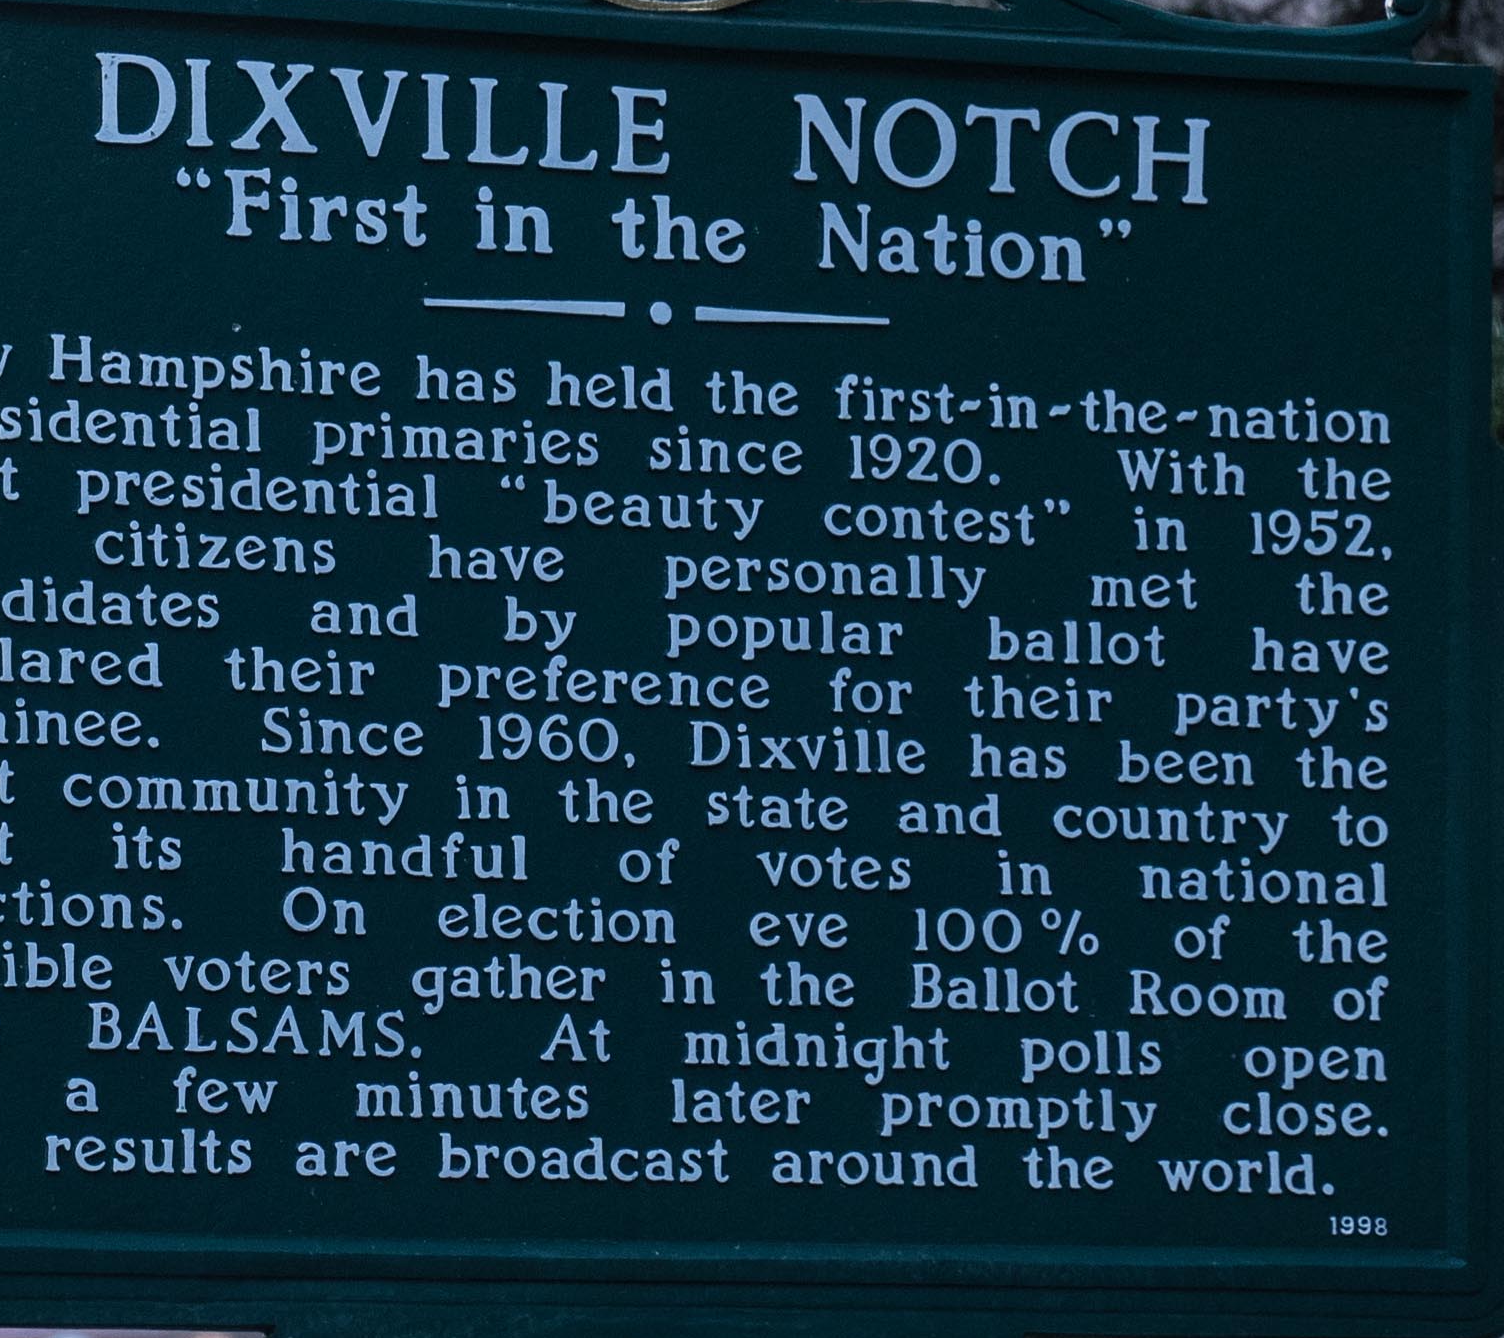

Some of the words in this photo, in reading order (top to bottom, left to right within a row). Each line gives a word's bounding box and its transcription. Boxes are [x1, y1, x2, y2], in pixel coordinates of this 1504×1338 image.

[92, 50, 672, 175] DIXVILLE
[791, 92, 1212, 206] NOTCH
[473, 184, 555, 255] in
[609, 193, 748, 265] the
[47, 331, 382, 401] Hampshire
[414, 353, 518, 405] has
[545, 359, 675, 413] held
[703, 368, 800, 418] the
[310, 410, 600, 468] primaries
[648, 423, 804, 477] since
[848, 431, 1002, 487] 1920.
[1115, 446, 1246, 497] With
[1295, 455, 1393, 503] the
[75, 461, 439, 520] presidential
[1132, 504, 1189, 553] in
[1249, 507, 1394, 562] 1952,
[93, 518, 337, 576] citizens
[427, 532, 566, 583] have
[663, 553, 988, 610] personally
[1089, 567, 1199, 611] met
[1294, 569, 1390, 618] the
[309, 592, 420, 638] and
[502, 594, 578, 653] by
[665, 608, 905, 662] popular
[987, 614, 1167, 668] ballot
[1250, 625, 1391, 676] have
[222, 644, 376, 697] their
[436, 653, 771, 710] preference
[827, 665, 914, 716] for
[962, 673, 1114, 723] their
[1173, 685, 1390, 740] party's
[259, 704, 425, 758] Since
[477, 710, 637, 770] 1960,
[688, 719, 927, 776] Dixville
[968, 731, 1068, 780] has
[1116, 738, 1256, 787] been
[1294, 743, 1389, 791] the
[61, 766, 410, 827] community
[454, 772, 512, 821] in
[556, 776, 655, 826] the
[706, 783, 850, 832] state
[897, 792, 1004, 838] and
[1051, 799, 1290, 856] country
[1330, 803, 1390, 849] to
[110, 820, 183, 872] its
[280, 825, 529, 882] handful
[617, 836, 682, 886] of
[754, 845, 913, 892] votes
[996, 847, 1054, 897] in
[1137, 855, 1389, 908] national
[281, 884, 368, 936] On
[436, 891, 678, 945] election
[748, 910, 849, 949] eve
[1172, 912, 1232, 961] of
[1290, 916, 1389, 965] the
[162, 949, 351, 997] voters
[410, 951, 607, 1016] gather
[659, 956, 717, 1006] in
[758, 959, 856, 1009] the
[909, 961, 1081, 1015] Ballot
[1128, 967, 1288, 1021] Room
[1331, 973, 1391, 1022] of
[86, 999, 423, 1060] BALSAMS.
[538, 1011, 612, 1064] At
[683, 1019, 952, 1087] midnight
[1019, 1028, 1163, 1085] polls
[1242, 1044, 1389, 1091] open
[64, 1075, 100, 1113] a
[171, 1064, 280, 1116] few
[354, 1069, 590, 1121] minutes
[670, 1076, 812, 1126] later
[879, 1086, 1159, 1144] promptly
[1221, 1090, 1390, 1138] close.
[44, 1126, 253, 1176] results
[294, 1139, 398, 1178] are
[437, 1130, 731, 1184] broadcast
[770, 1142, 980, 1189] around
[1020, 1143, 1115, 1191] the
[1156, 1148, 1336, 1197] world.
[1328, 1214, 1389, 1237] 1998
